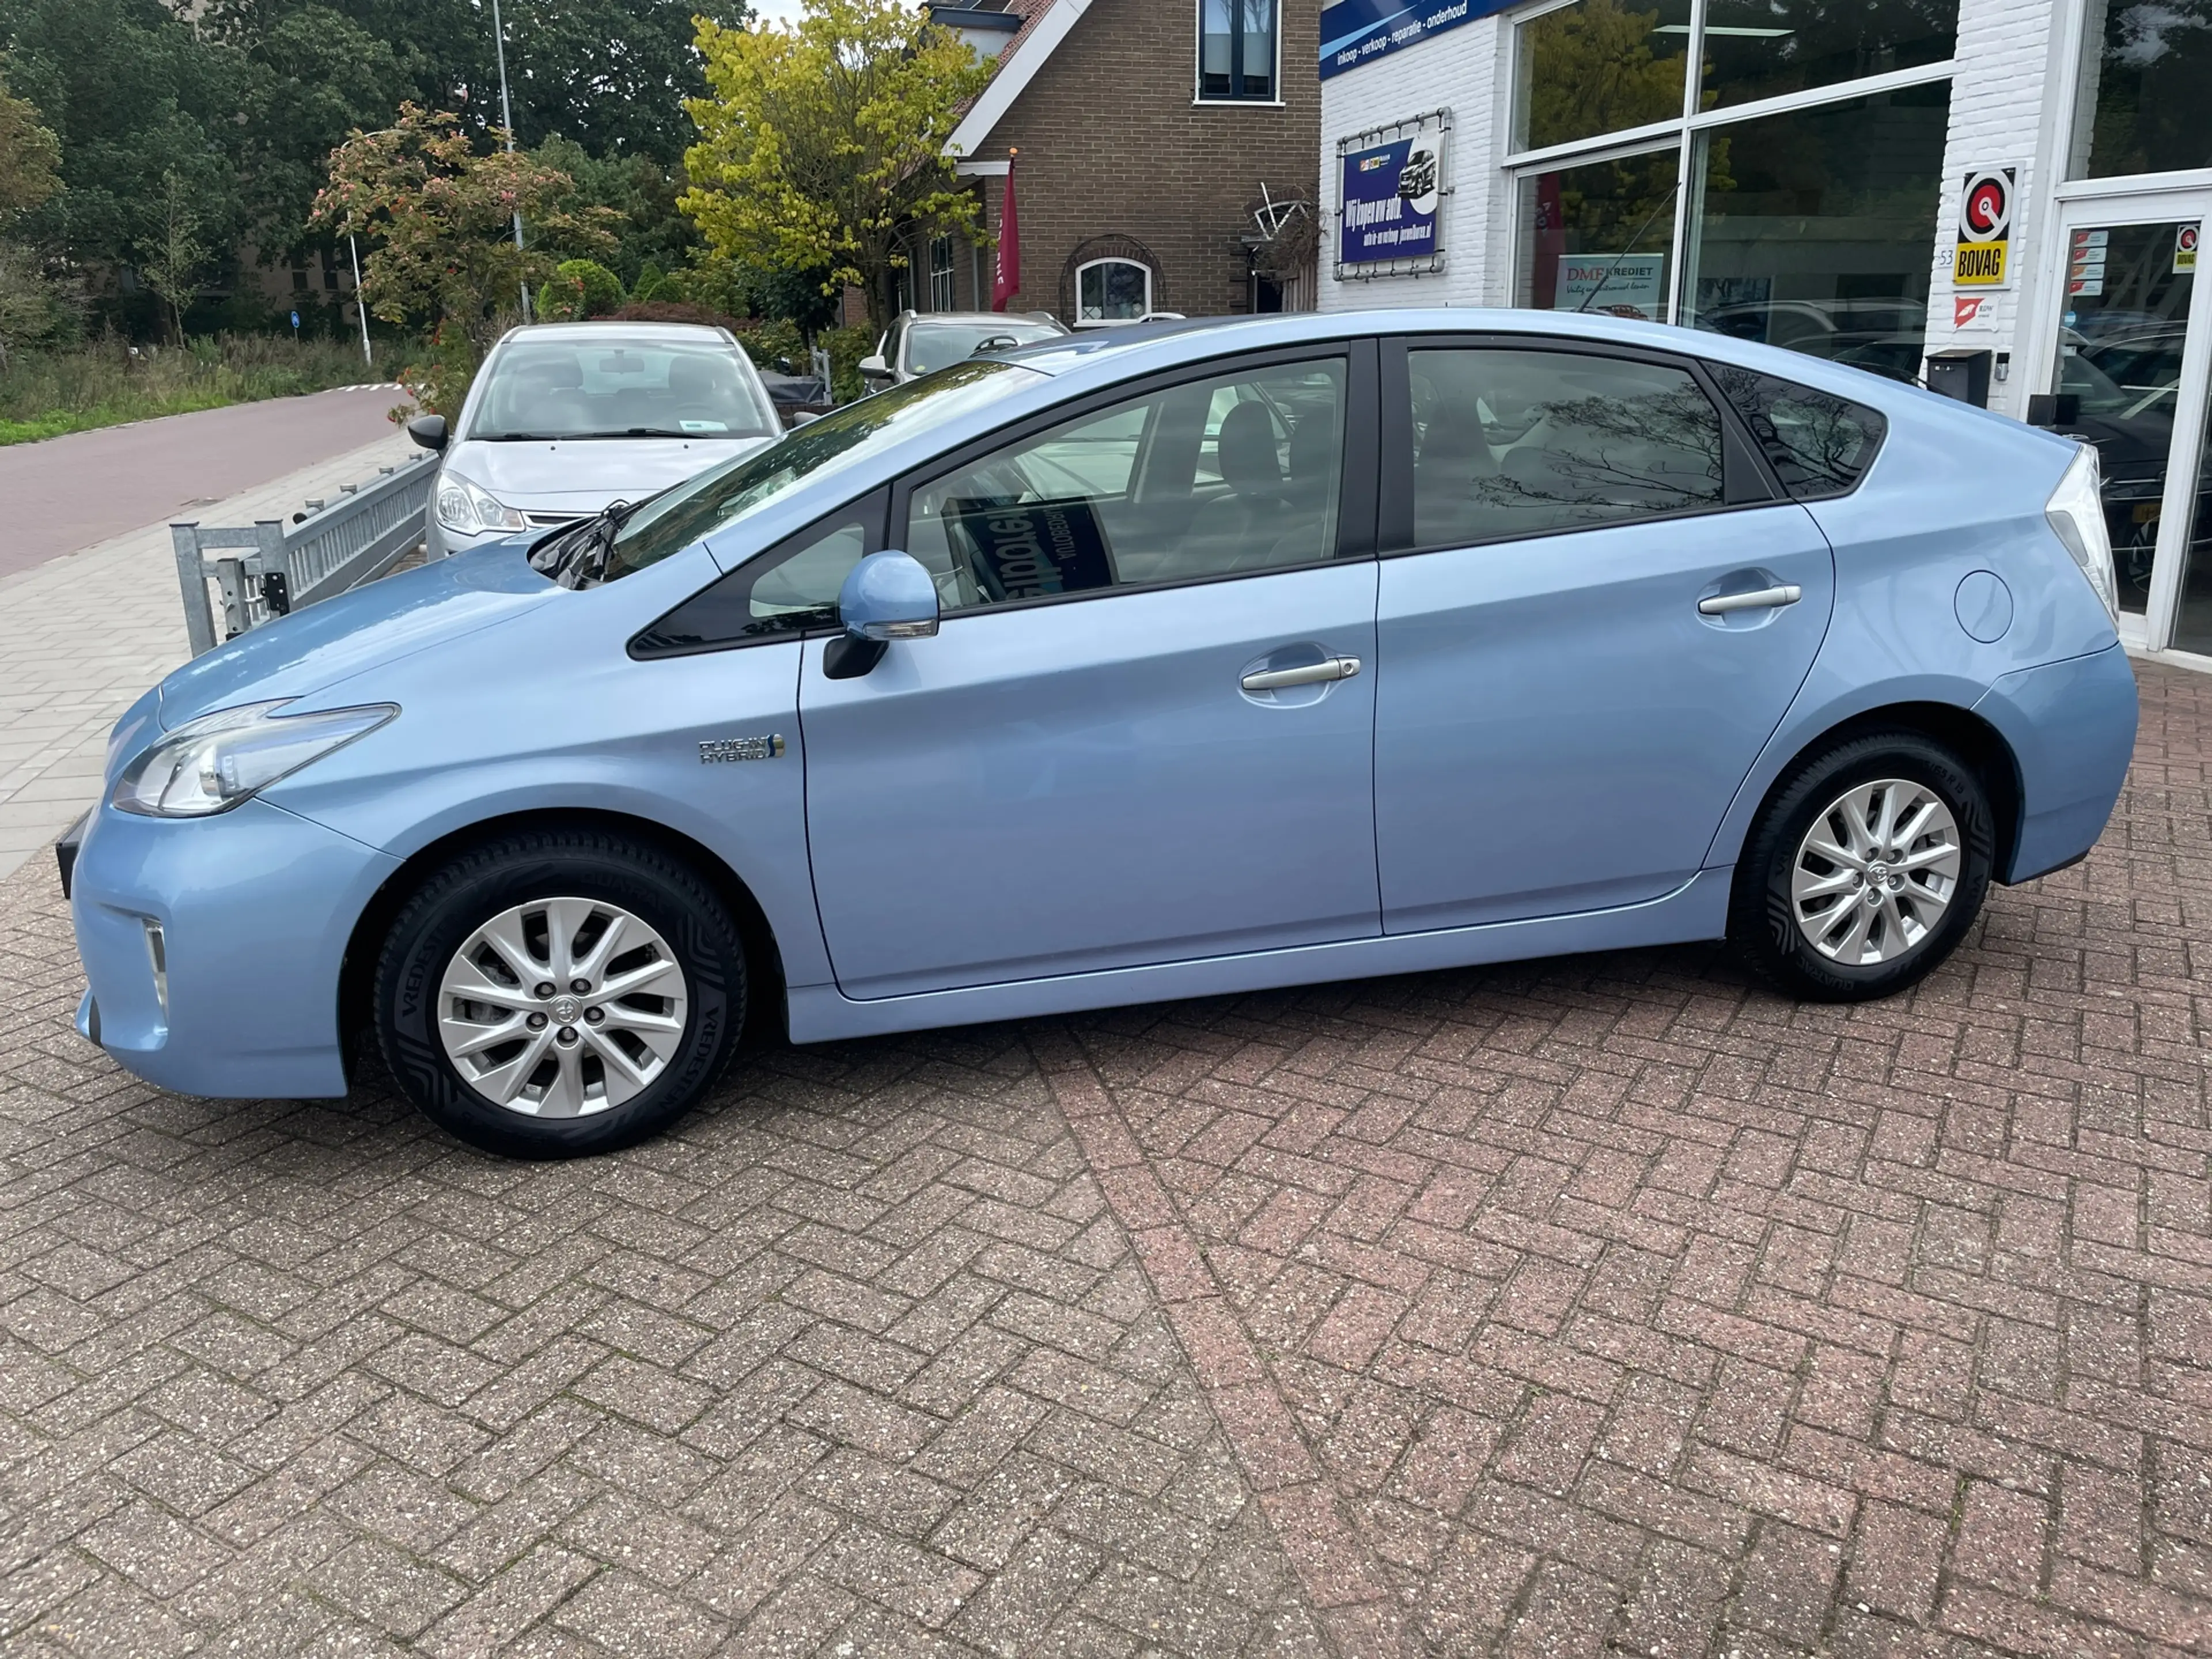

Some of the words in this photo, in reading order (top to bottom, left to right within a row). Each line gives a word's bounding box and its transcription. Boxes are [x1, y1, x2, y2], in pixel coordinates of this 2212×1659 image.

[1337, 48, 1357, 66] inkoop
[1361, 35, 1387, 56] verkoop
[1391, 20, 1422, 44] reparatie
[1427, 1, 1468, 29] onderhoud
[1940, 250, 1953, 266] 53
[1958, 248, 2001, 277] BOVAG
[1567, 267, 1604, 281] DMF
[1606, 267, 1653, 276] KREDIET
[699, 749, 769, 764] HYBRID
